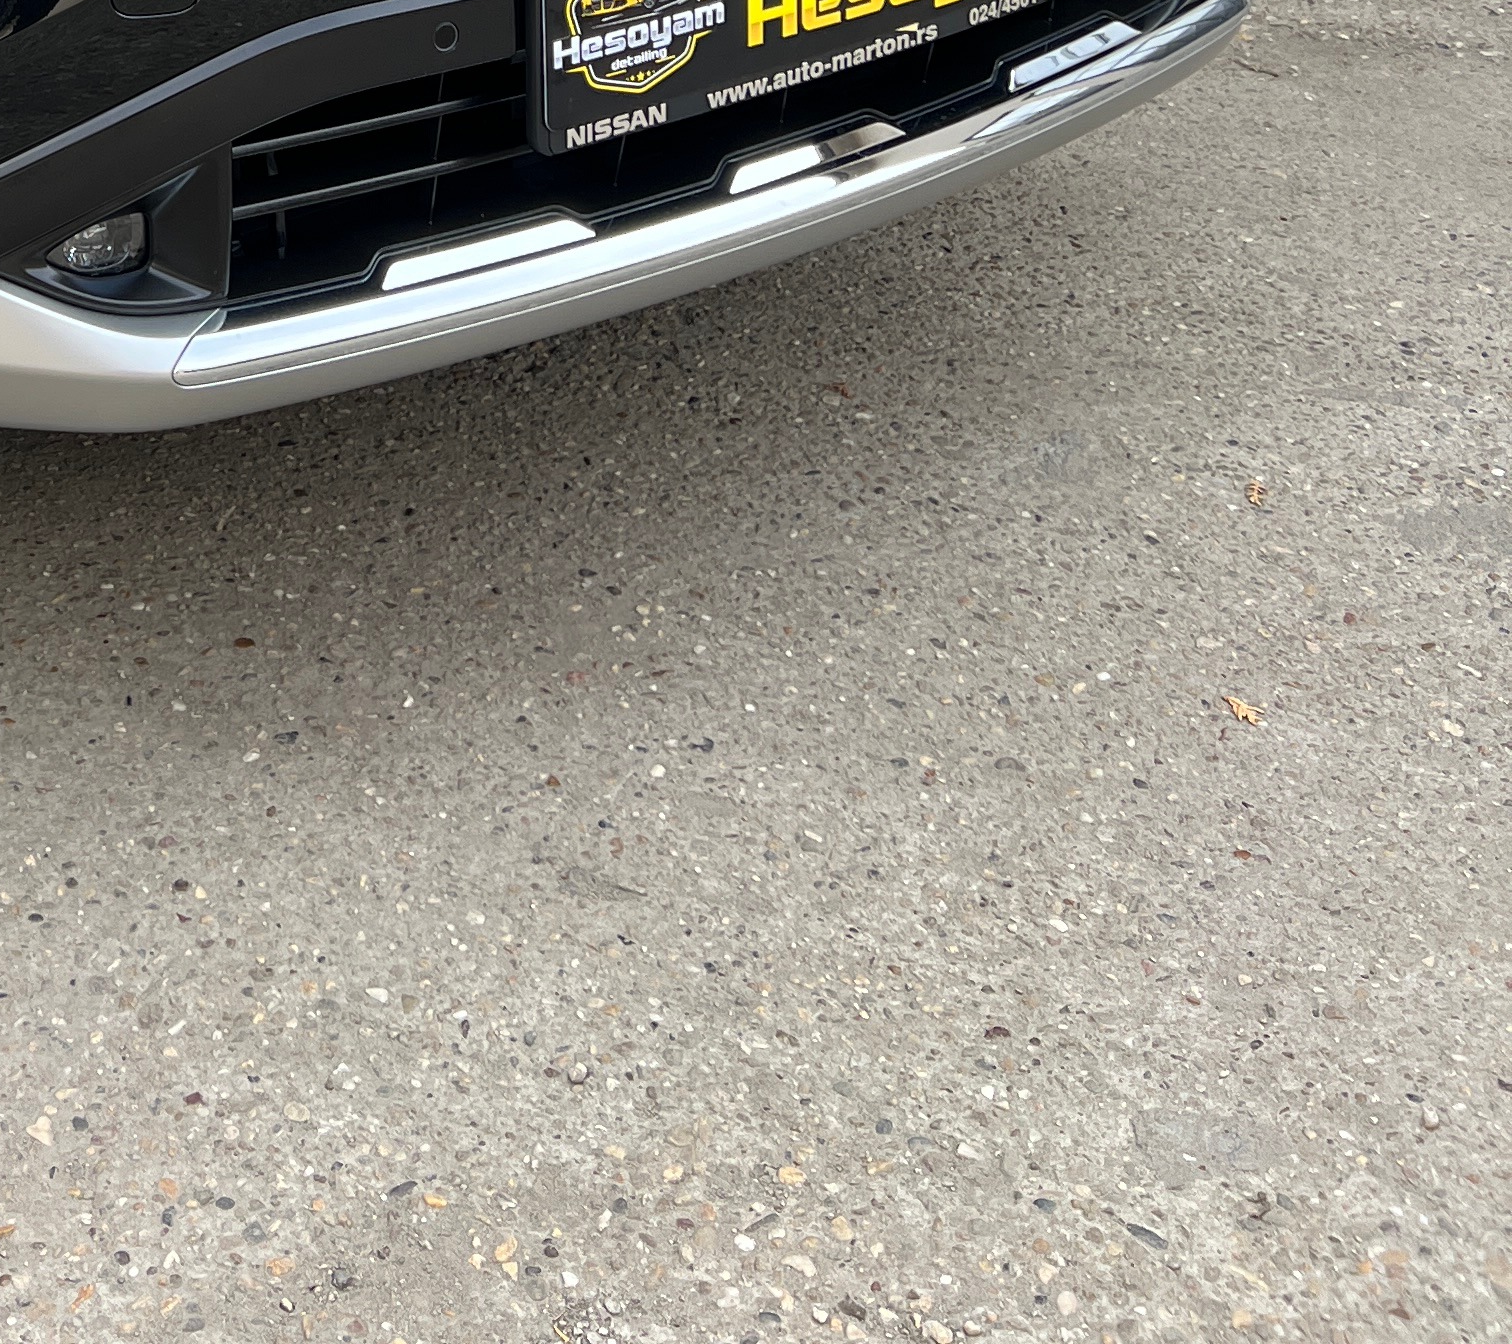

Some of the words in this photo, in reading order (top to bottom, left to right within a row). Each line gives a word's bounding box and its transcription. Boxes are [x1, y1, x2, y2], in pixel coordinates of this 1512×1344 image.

[552, 0, 726, 71] Hesoyam
[610, 46, 668, 71] detailing
[706, 22, 939, 110] www.auto-marton.rs
[566, 103, 668, 149] NISSAN
